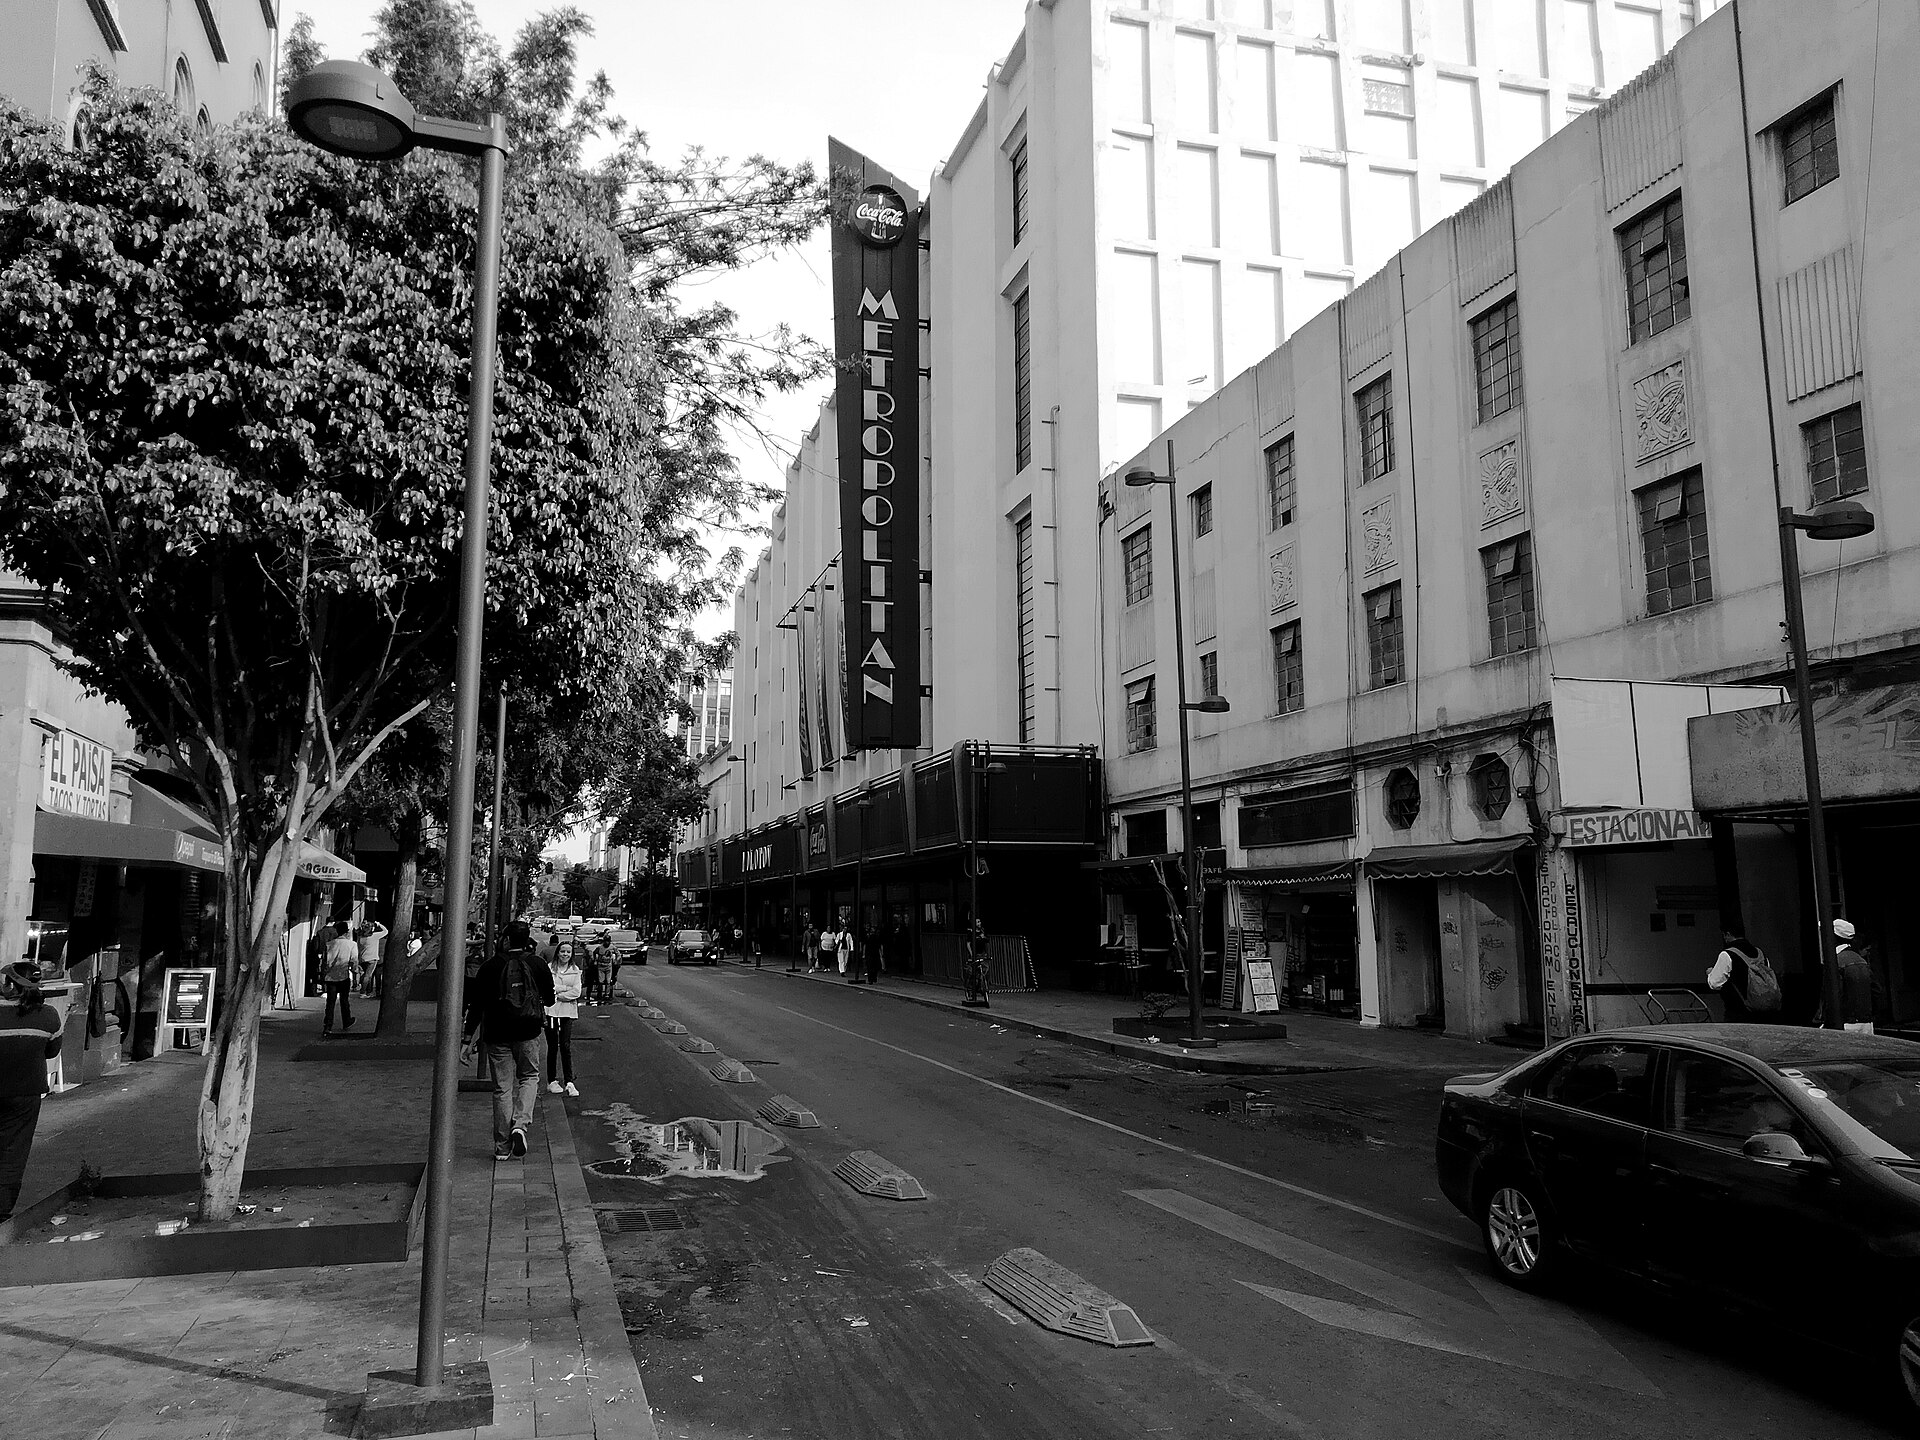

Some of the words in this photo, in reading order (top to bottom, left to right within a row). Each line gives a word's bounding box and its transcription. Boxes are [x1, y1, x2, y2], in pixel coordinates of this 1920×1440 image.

[857, 287, 899, 705] METROPOLITAN
[51, 732, 67, 785] EL
[50, 786, 73, 812] TACOS
[76, 794, 82, 813] Y
[83, 796, 106, 820] TORTAS
[1551, 881, 1561, 972] PUBLICO
